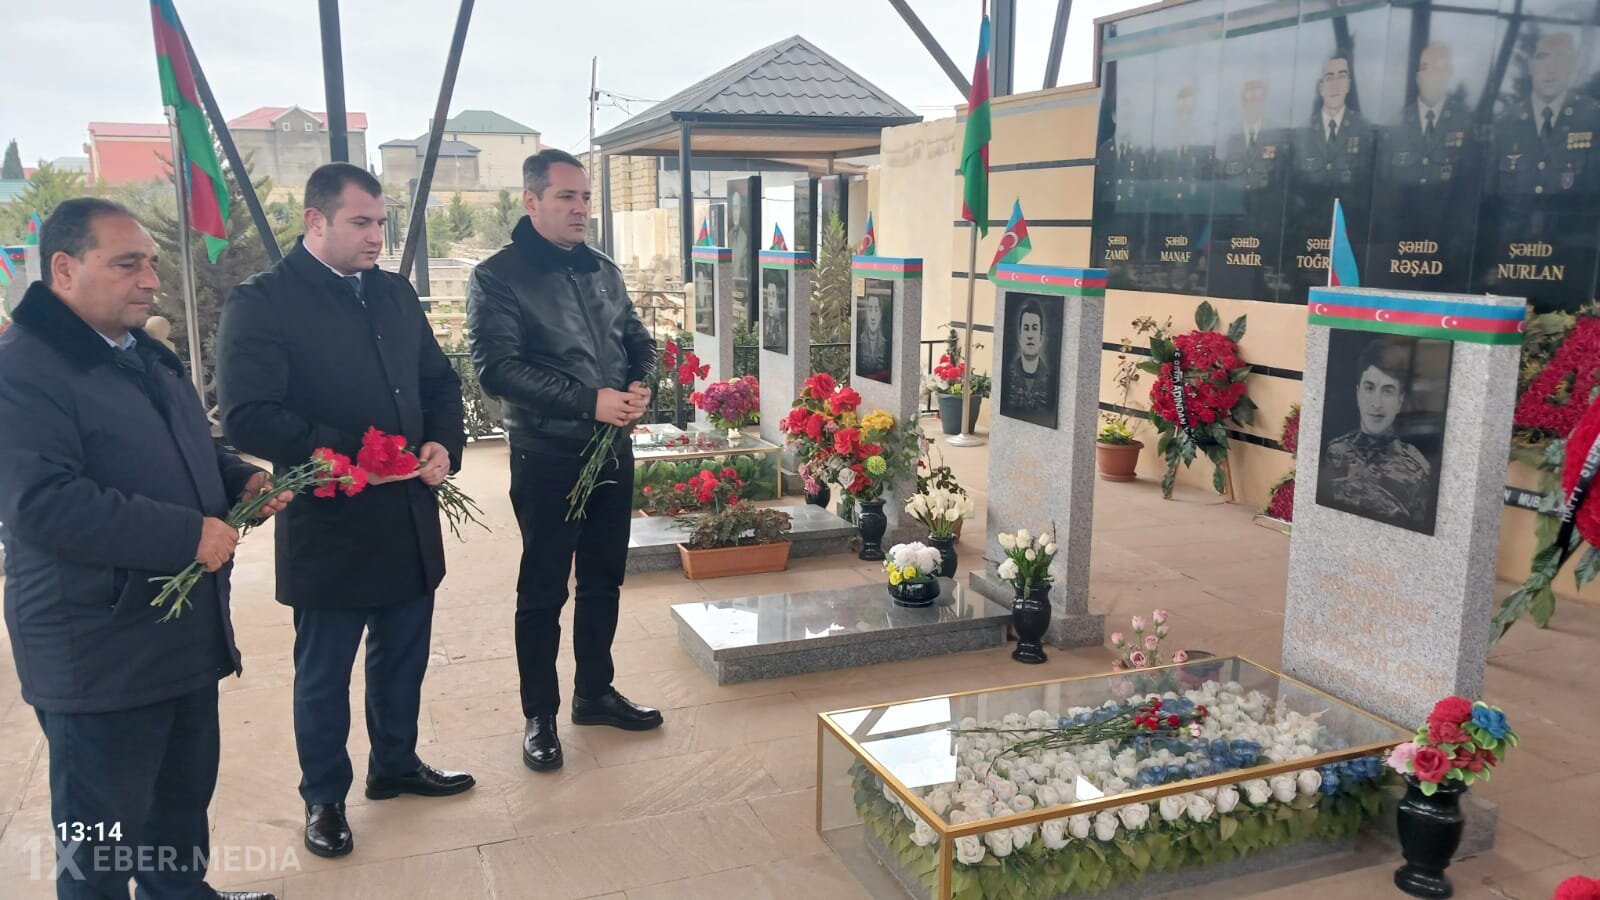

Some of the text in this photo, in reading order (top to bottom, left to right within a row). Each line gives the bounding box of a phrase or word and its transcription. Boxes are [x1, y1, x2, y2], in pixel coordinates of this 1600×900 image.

[1398, 239, 1439, 255] ŞƏHİD
[1509, 240, 1553, 259] ŞƏHİD
[1160, 250, 1192, 263] MANAF
[1226, 251, 1262, 266] SAMİR
[1296, 253, 1330, 269] TOĞR
[1389, 259, 1443, 277] RƏŞAD
[1497, 263, 1565, 281] NURLAN
